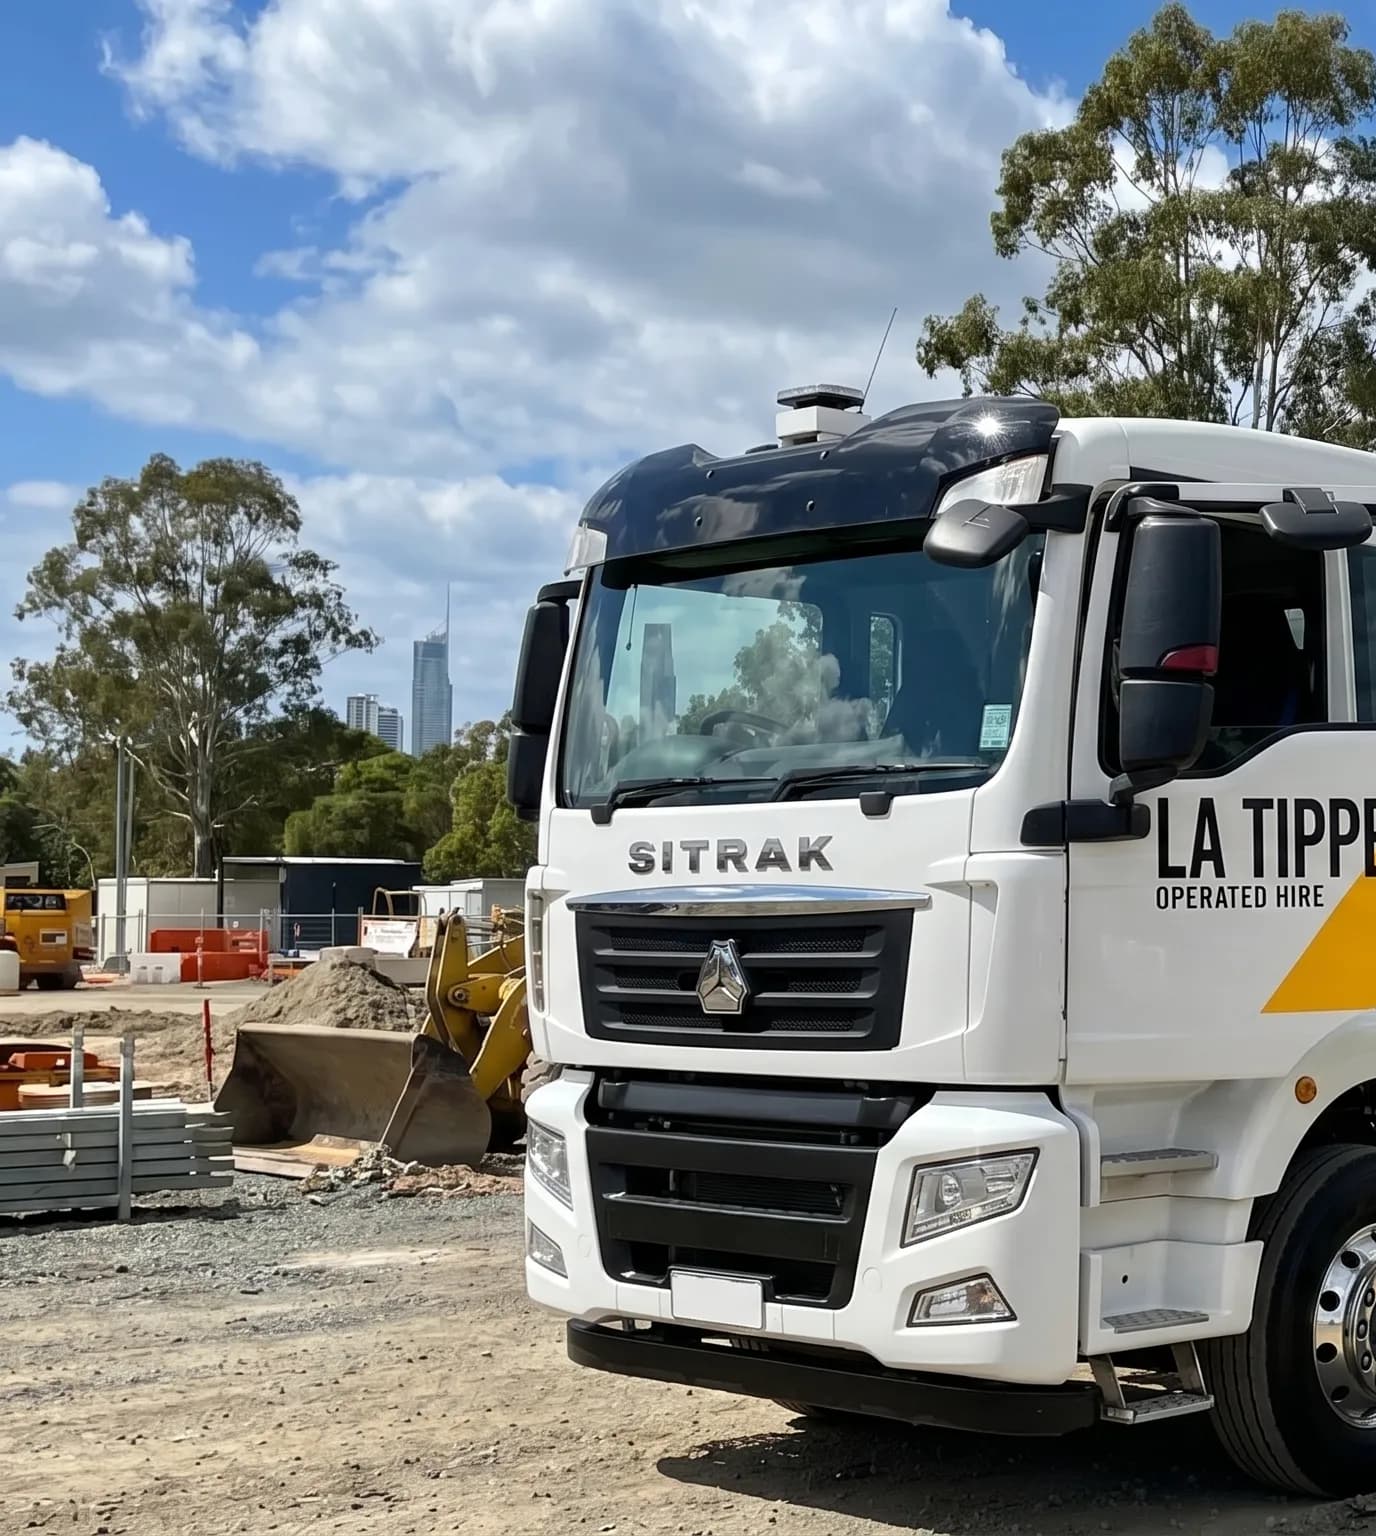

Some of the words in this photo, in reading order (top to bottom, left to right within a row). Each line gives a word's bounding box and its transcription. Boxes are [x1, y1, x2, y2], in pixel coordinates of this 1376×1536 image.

[628, 835, 834, 874] SITRAK
[1157, 797, 1226, 879] LA
[1156, 885, 1267, 910] OPERATED
[1276, 884, 1325, 909] HIRE
